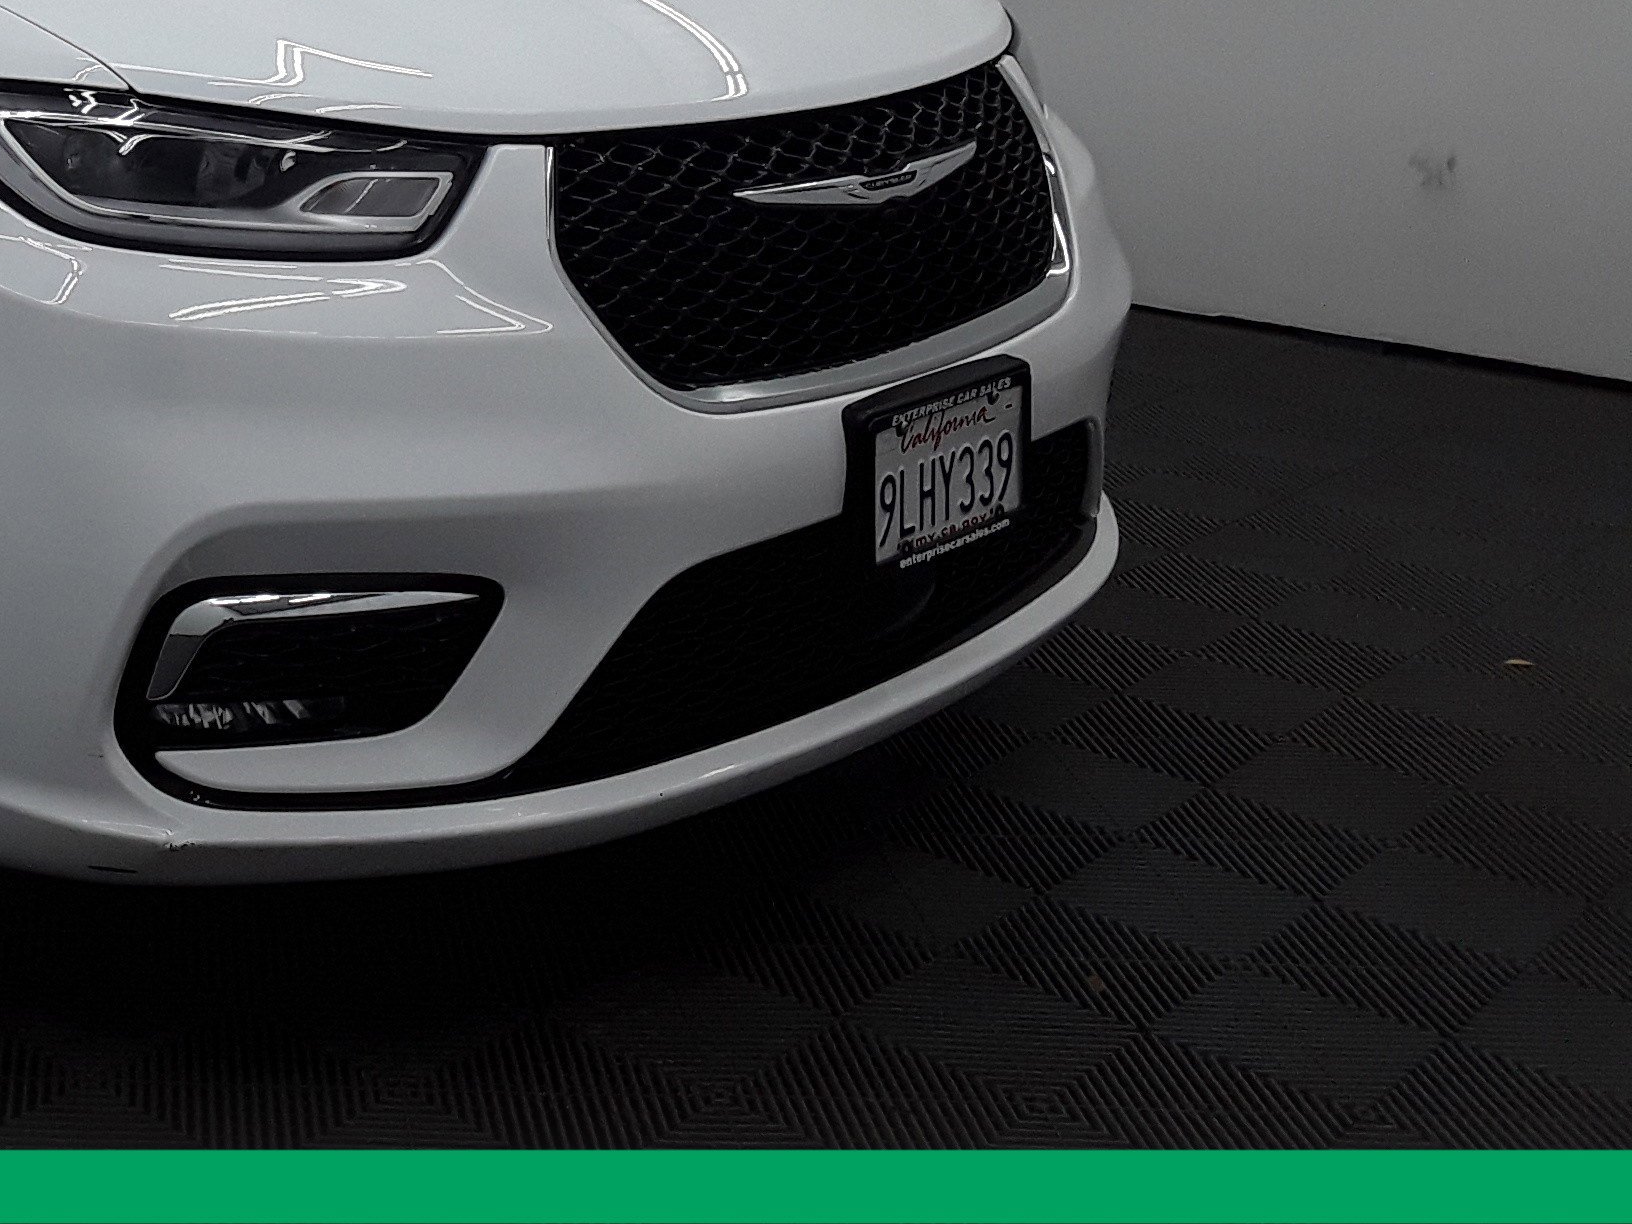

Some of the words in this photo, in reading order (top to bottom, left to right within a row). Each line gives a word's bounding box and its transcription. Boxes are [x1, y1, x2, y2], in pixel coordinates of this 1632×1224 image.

[956, 388, 978, 405] CAR
[899, 405, 997, 454] California
[879, 430, 1013, 548] 9LHY339
